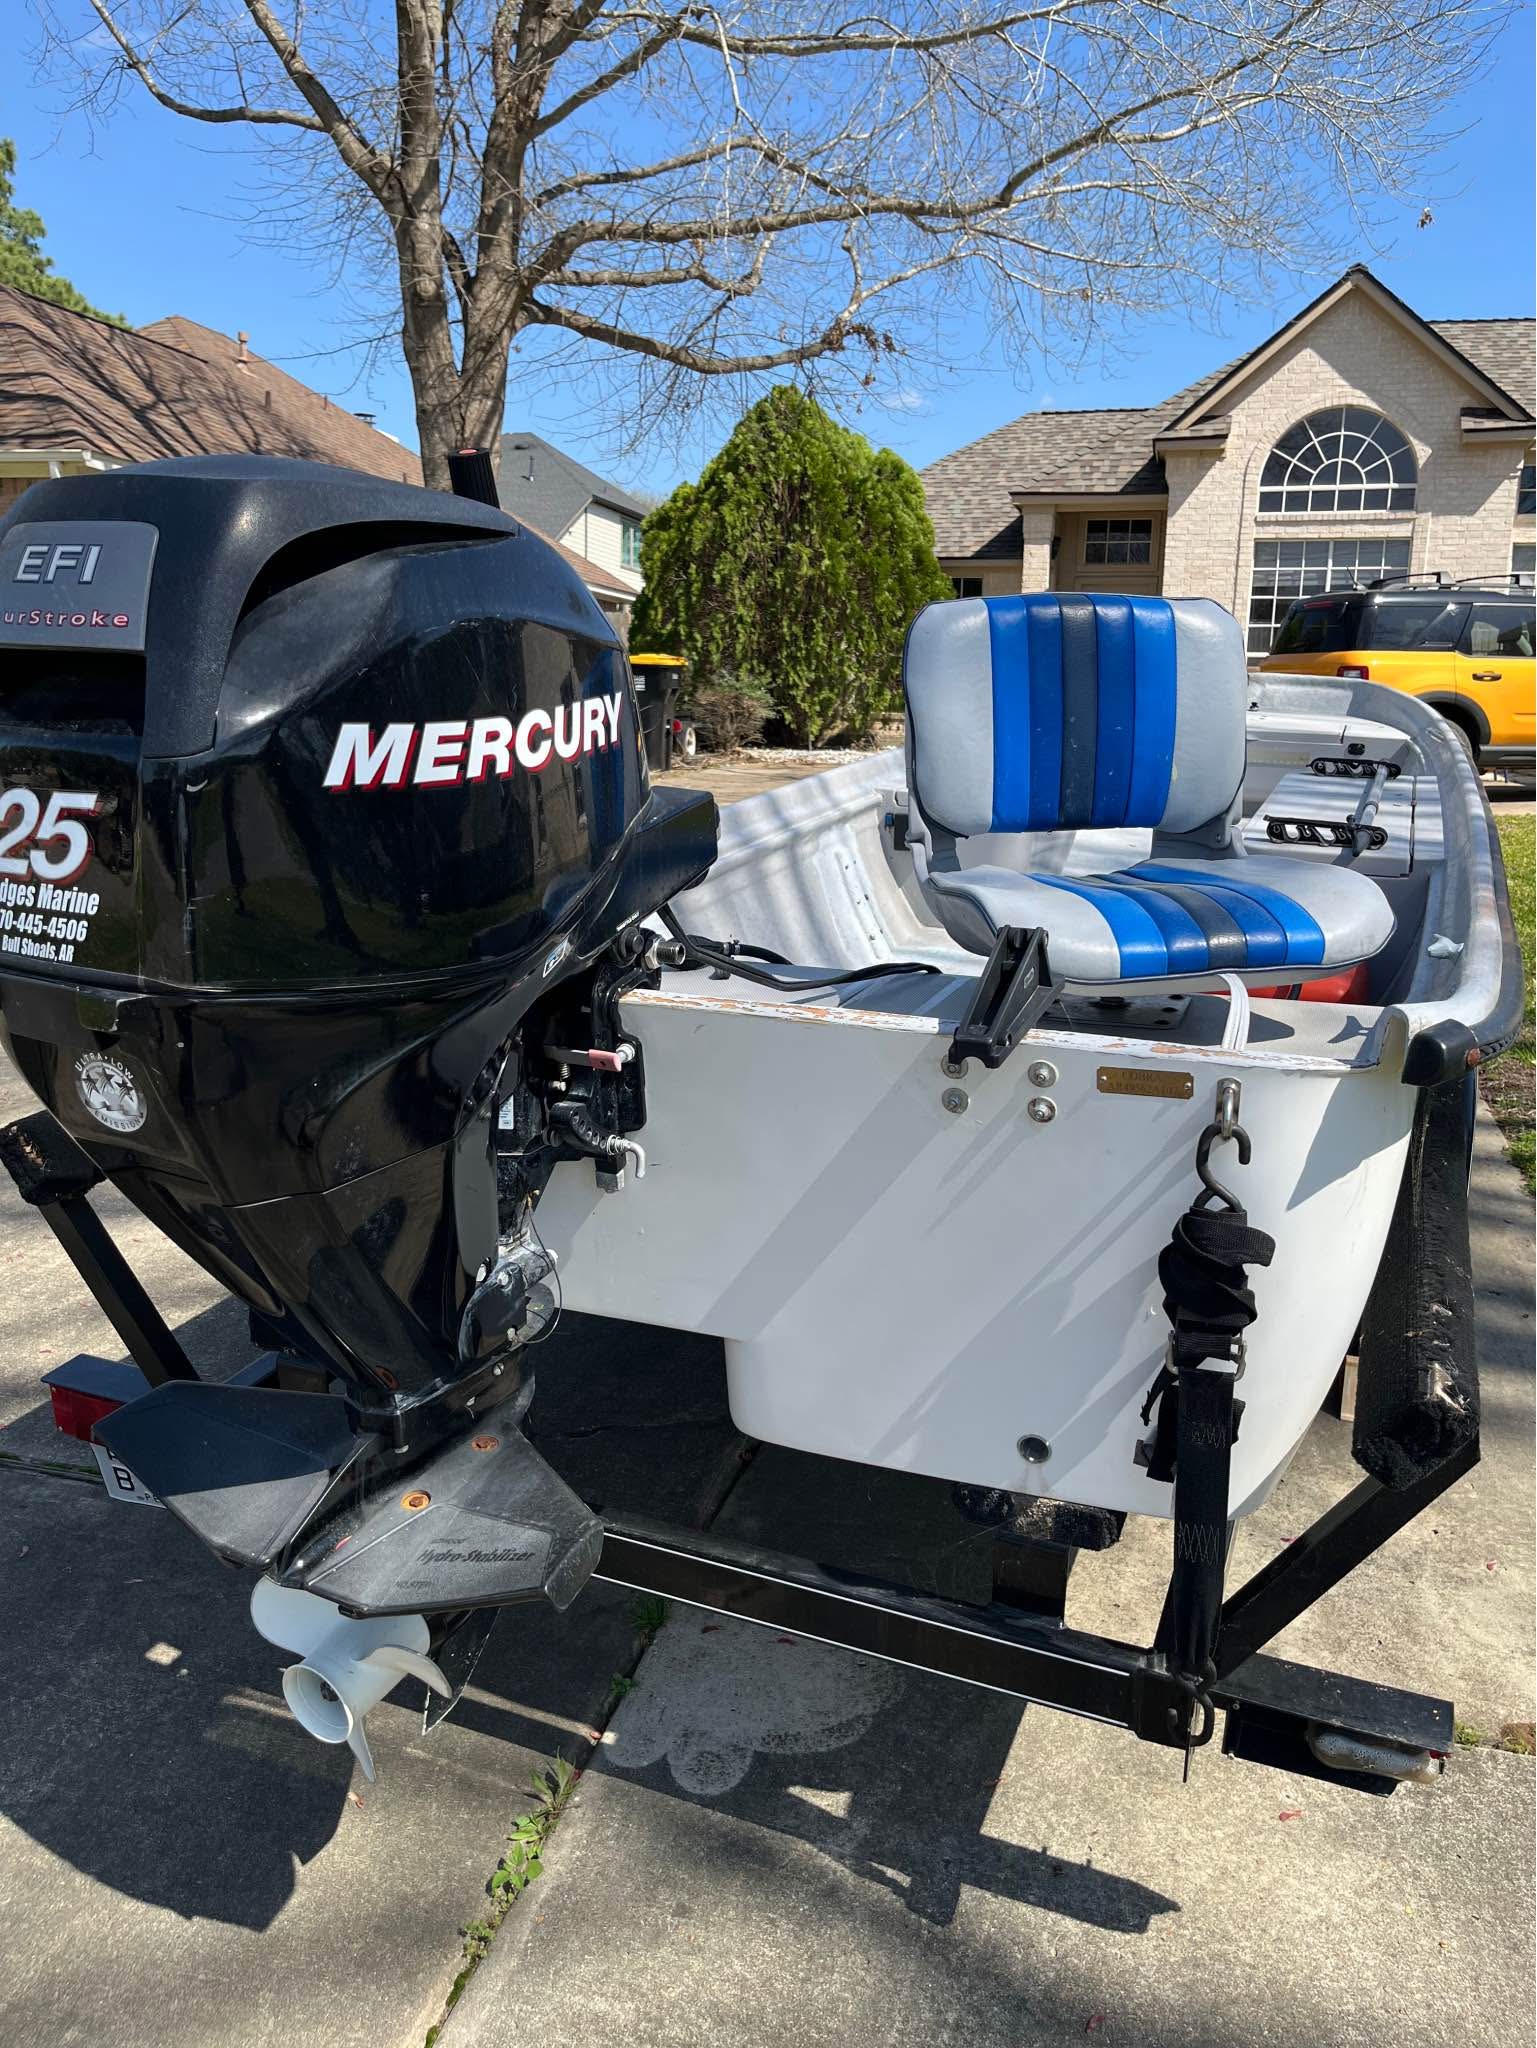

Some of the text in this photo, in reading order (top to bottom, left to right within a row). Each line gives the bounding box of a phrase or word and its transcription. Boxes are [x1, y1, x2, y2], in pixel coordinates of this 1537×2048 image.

[13, 544, 103, 584] EFI
[321, 692, 623, 793] MERCURY
[0, 787, 103, 885] 25
[37, 883, 100, 916] Marine
[2, 934, 75, 963] Bull Shoals, AR
[74, 1052, 134, 1080] ULTRA LOW
[416, 1548, 536, 1566] Hydro-Stabilizer
